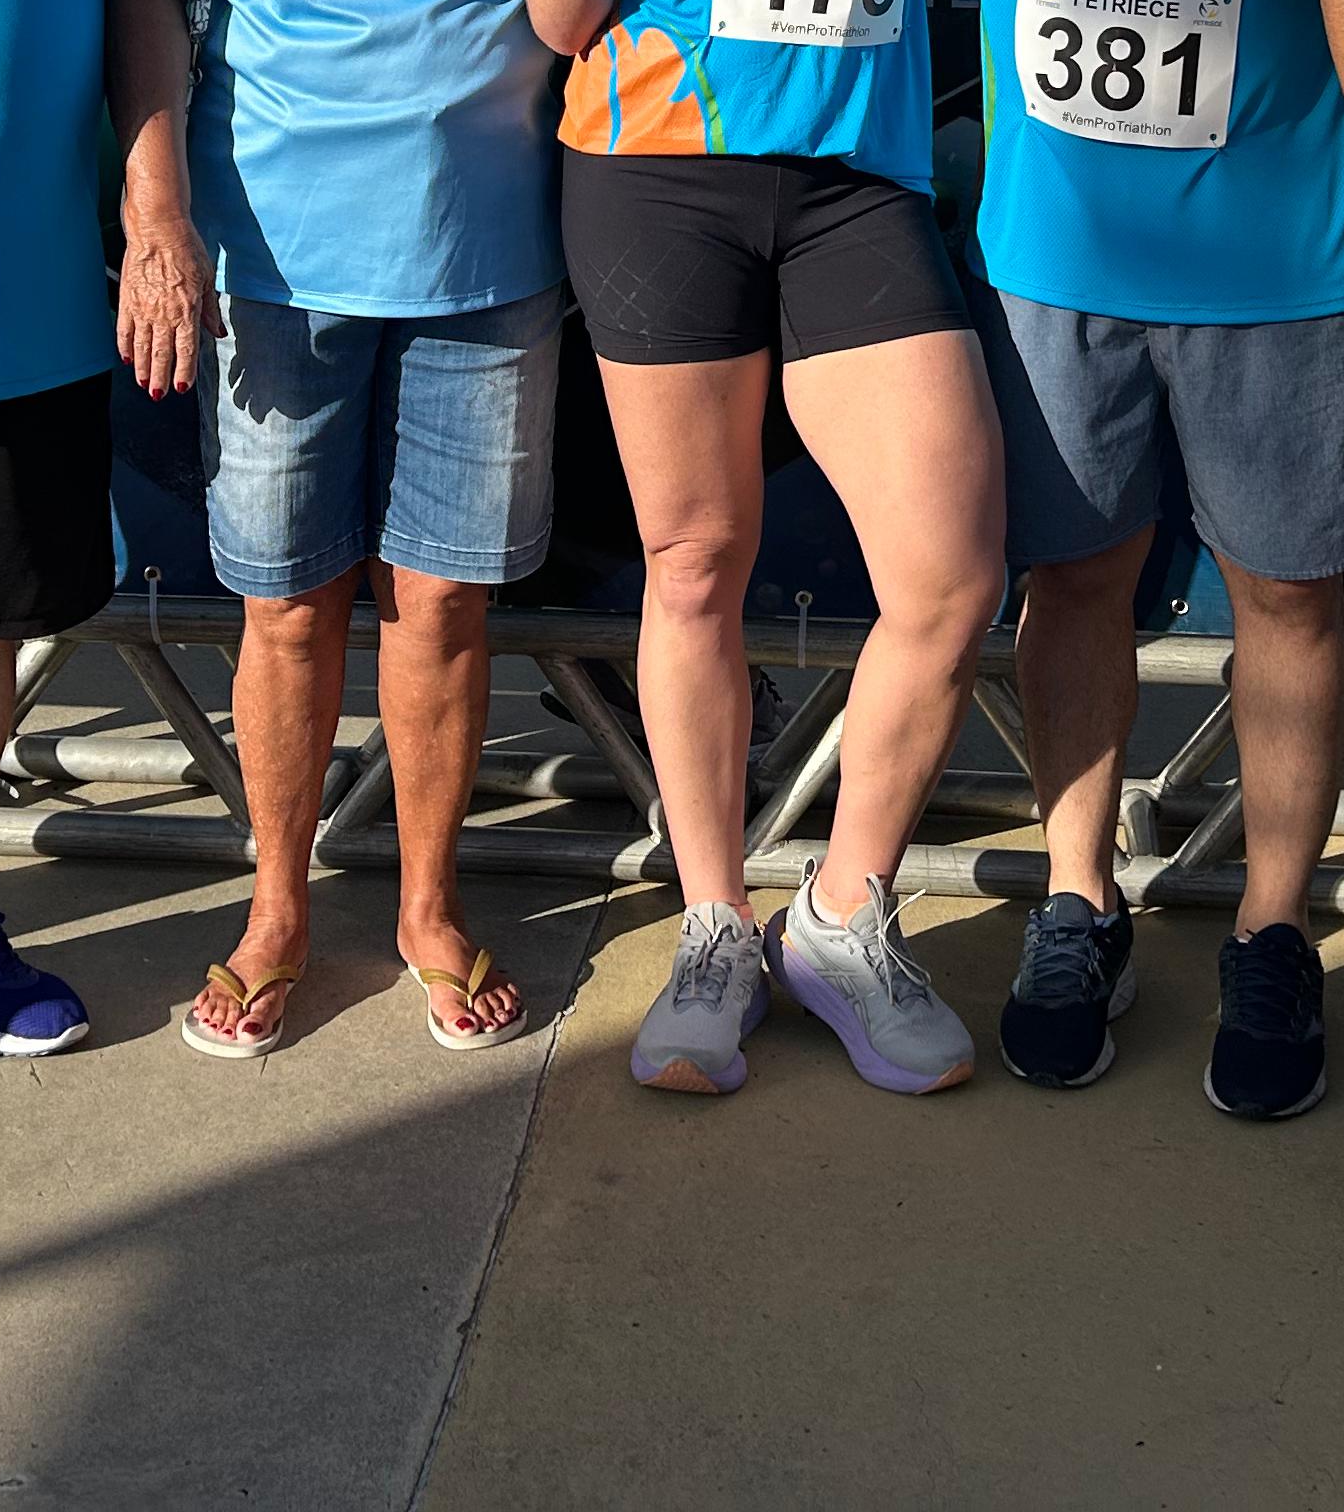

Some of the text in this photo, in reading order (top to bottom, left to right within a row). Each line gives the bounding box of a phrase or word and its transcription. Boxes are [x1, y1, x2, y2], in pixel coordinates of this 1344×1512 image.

[771, 20, 870, 37] #VemProTriathlon
[1035, 17, 1202, 116] 381
[1062, 111, 1172, 136] #VemProTriathlon
